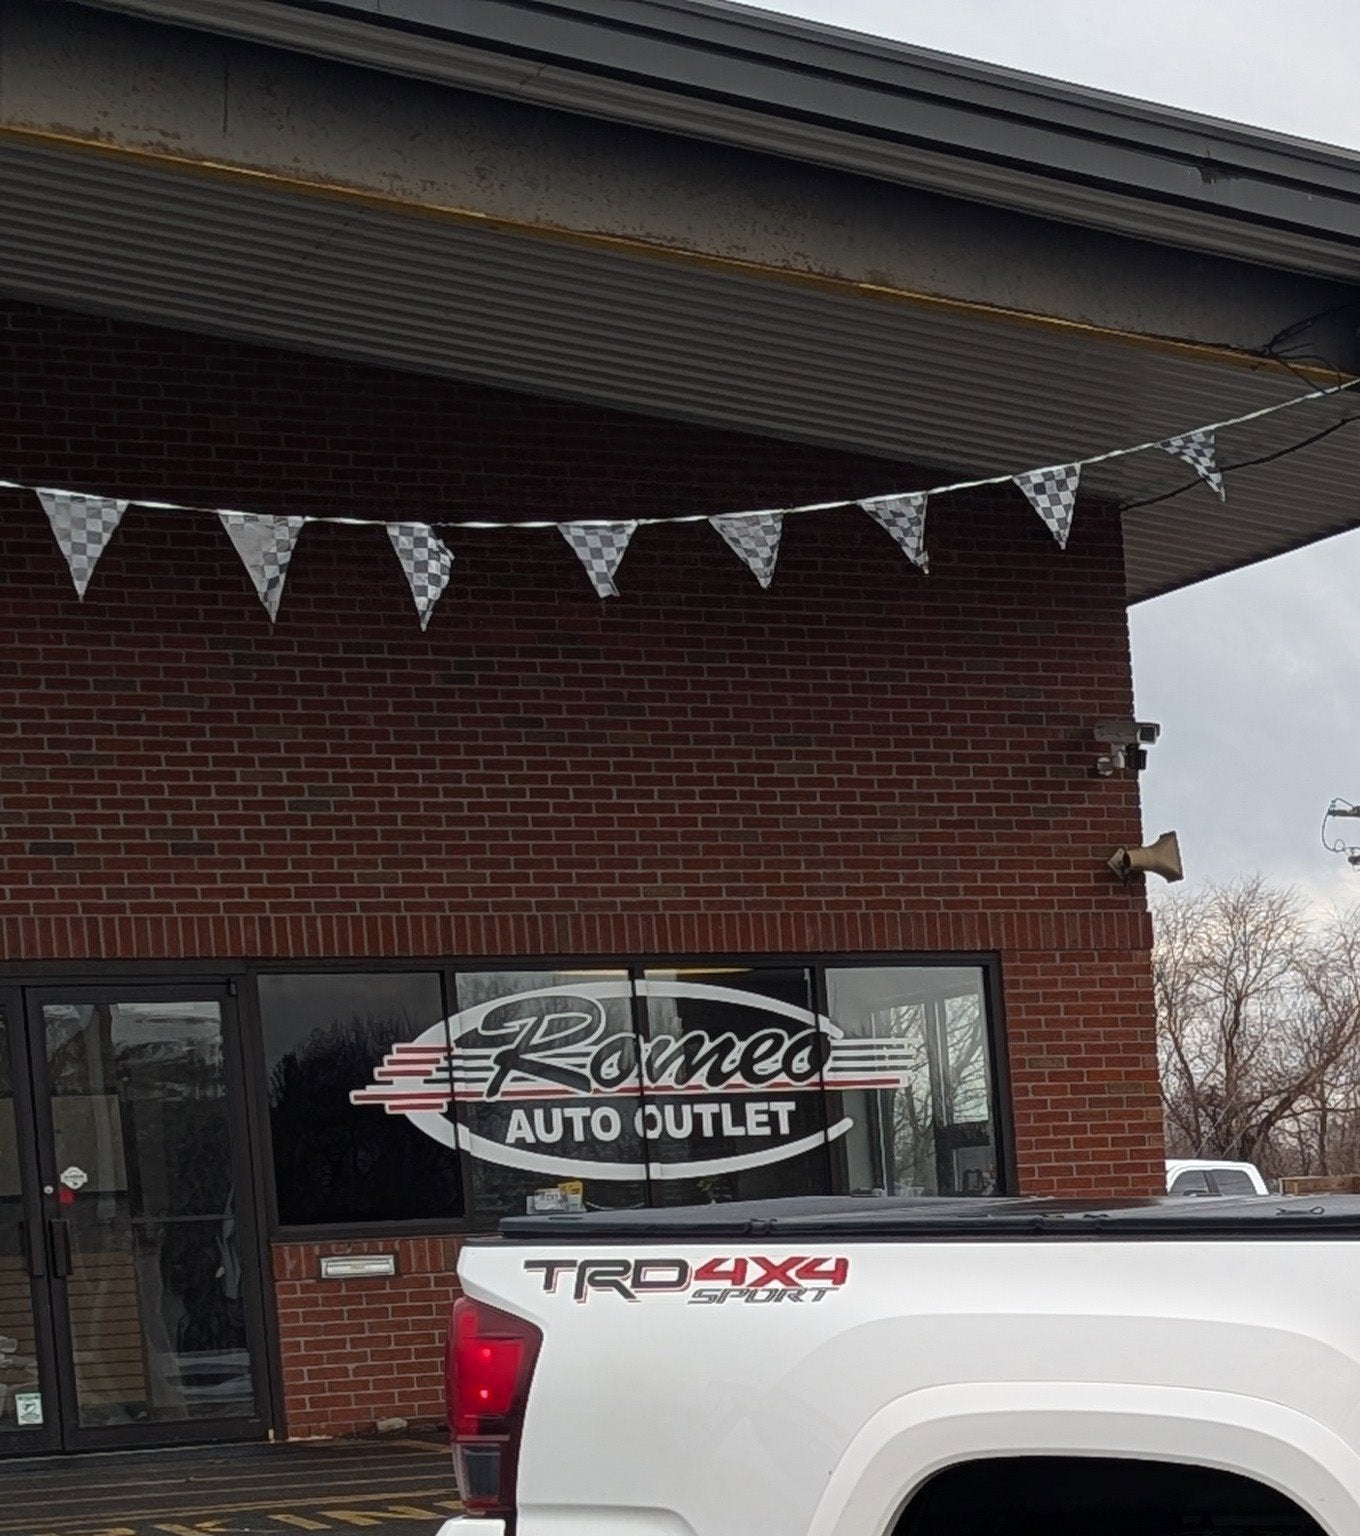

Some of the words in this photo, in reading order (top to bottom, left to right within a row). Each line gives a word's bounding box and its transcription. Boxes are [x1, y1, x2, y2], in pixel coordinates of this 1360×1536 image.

[477, 994, 833, 1099] Romeo
[506, 1108, 621, 1143] AUTO
[635, 1102, 796, 1139] OUTLET
[523, 1257, 694, 1304] TRD
[694, 1255, 850, 1288] 4X4
[687, 1286, 840, 1304] SPORT
